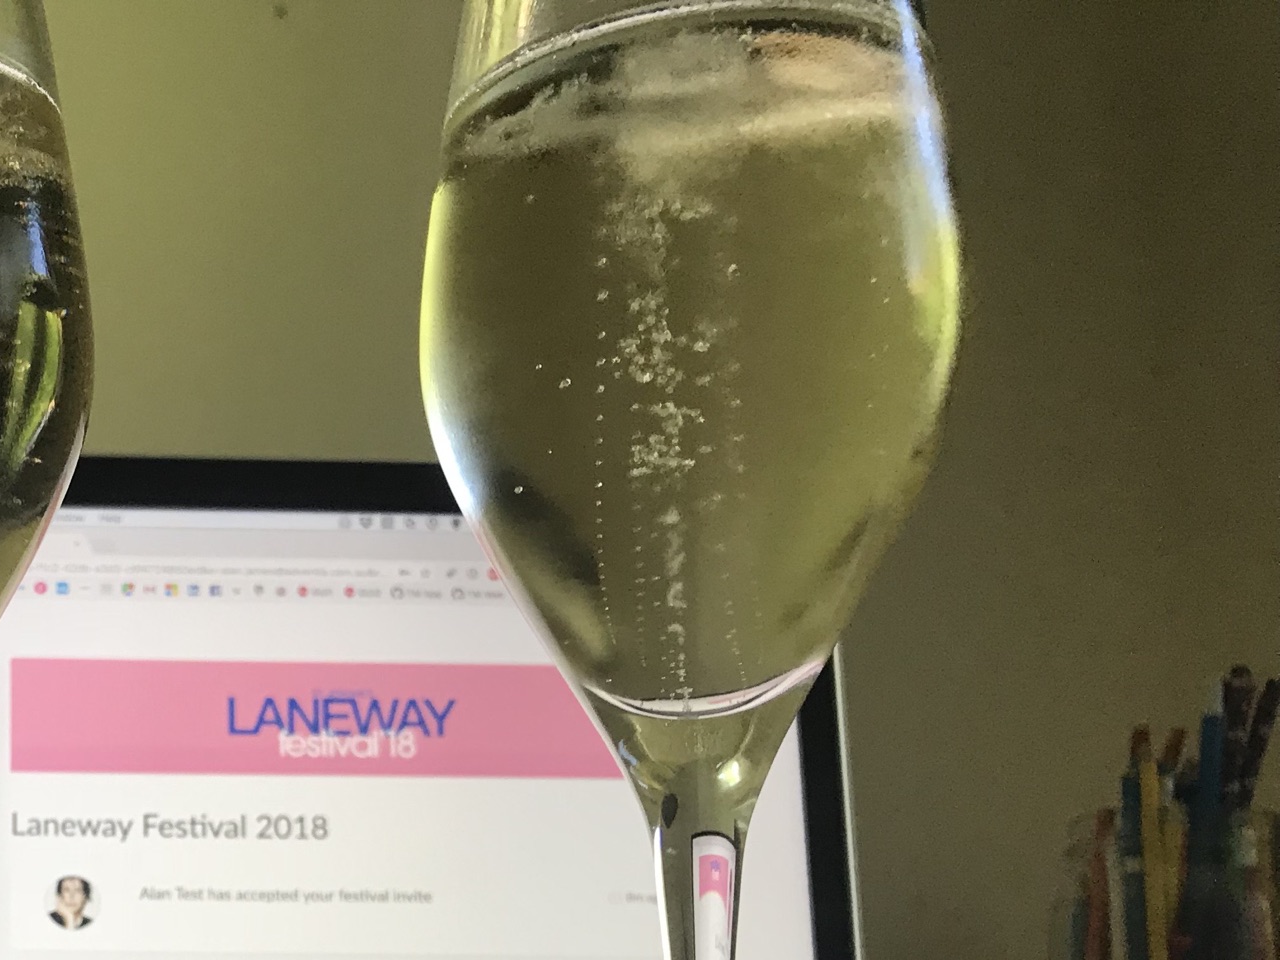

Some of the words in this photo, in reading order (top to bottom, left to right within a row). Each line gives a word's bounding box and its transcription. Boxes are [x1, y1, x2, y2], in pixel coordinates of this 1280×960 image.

[227, 696, 456, 737] LANEWAY
[278, 728, 379, 758] festival
[10, 811, 133, 843] Laneway
[142, 813, 247, 839] Festival
[255, 814, 329, 841] 2018
[138, 886, 170, 901] Alan
[174, 886, 203, 901] Test
[207, 887, 231, 901] has
[235, 888, 299, 905] accepted
[302, 891, 334, 905] your
[337, 888, 389, 904] festival
[392, 888, 432, 905] invite
